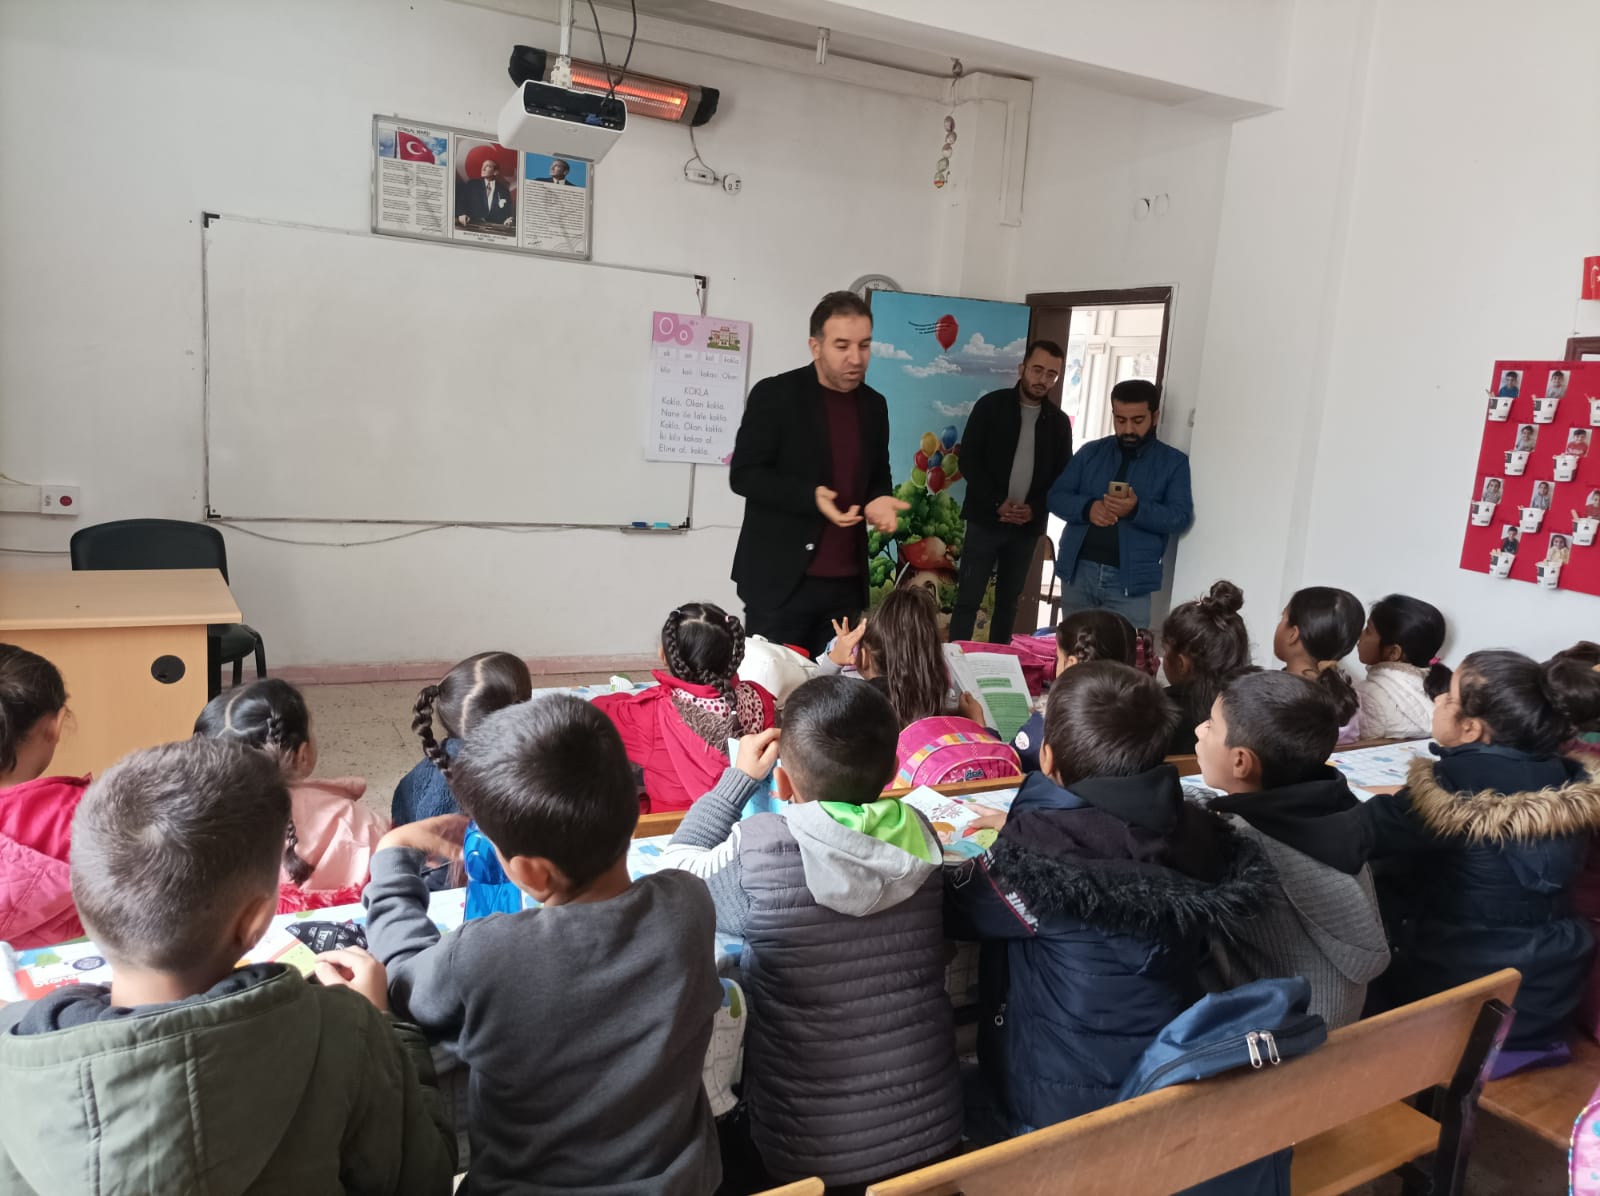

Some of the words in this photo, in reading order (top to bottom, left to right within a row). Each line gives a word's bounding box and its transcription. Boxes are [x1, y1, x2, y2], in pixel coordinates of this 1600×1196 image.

[684, 386, 708, 397] KOKLA
[686, 398, 704, 408] Okan
[684, 422, 702, 432] Okan
